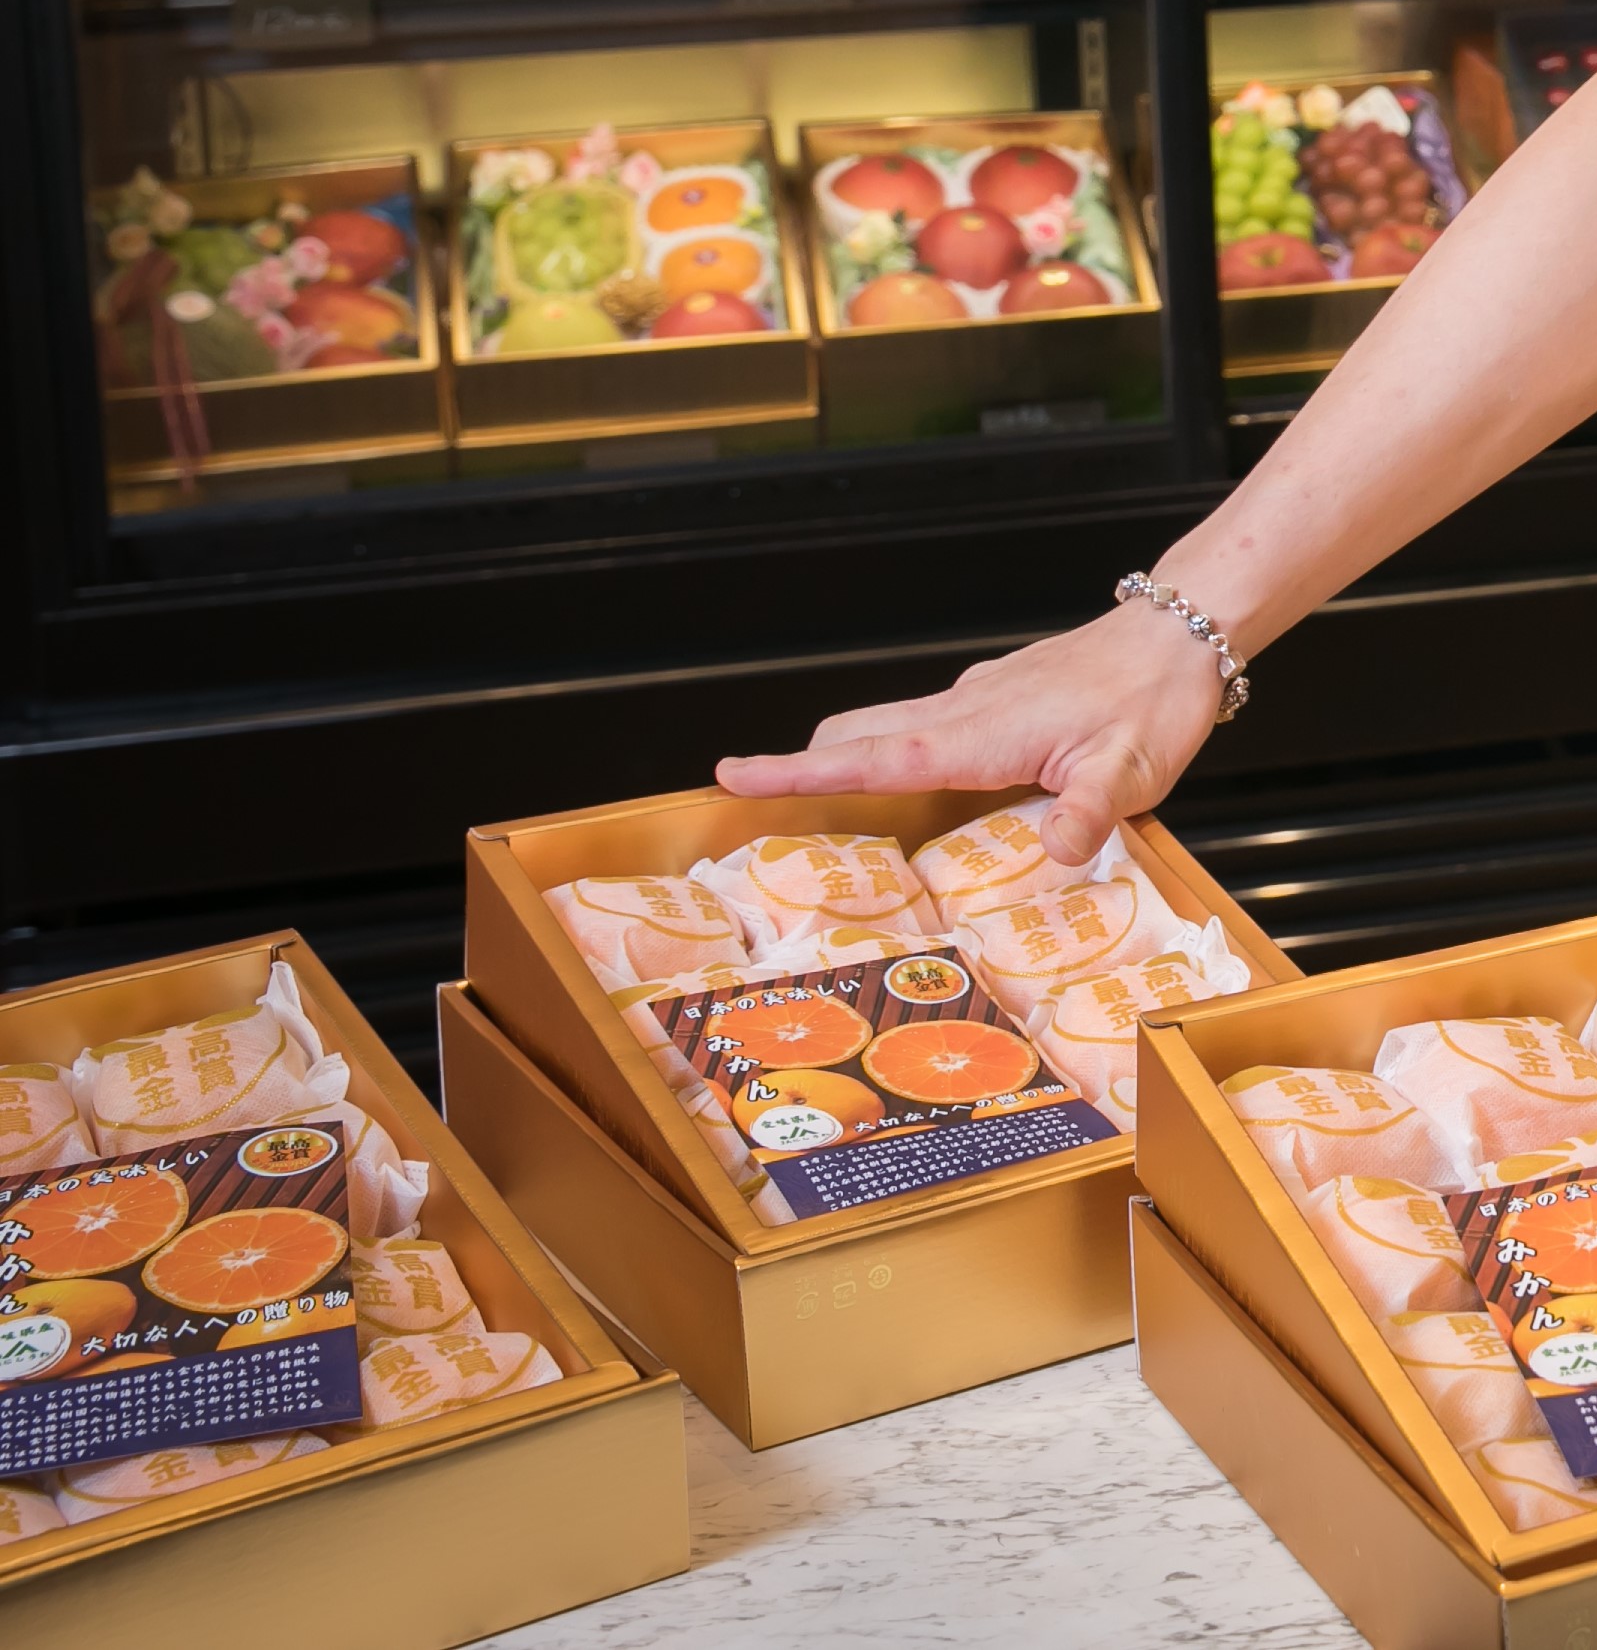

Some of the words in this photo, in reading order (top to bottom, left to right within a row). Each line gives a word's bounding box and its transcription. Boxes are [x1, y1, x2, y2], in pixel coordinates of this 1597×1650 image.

[683, 977, 861, 1019] 日本の美味しい
[705, 1033, 776, 1100] みかん
[853, 1080, 1064, 1133] 大切な人への贈り物
[1494, 1237, 1564, 1329] みかん
[82, 1289, 349, 1355] 大切な人への贈り物
